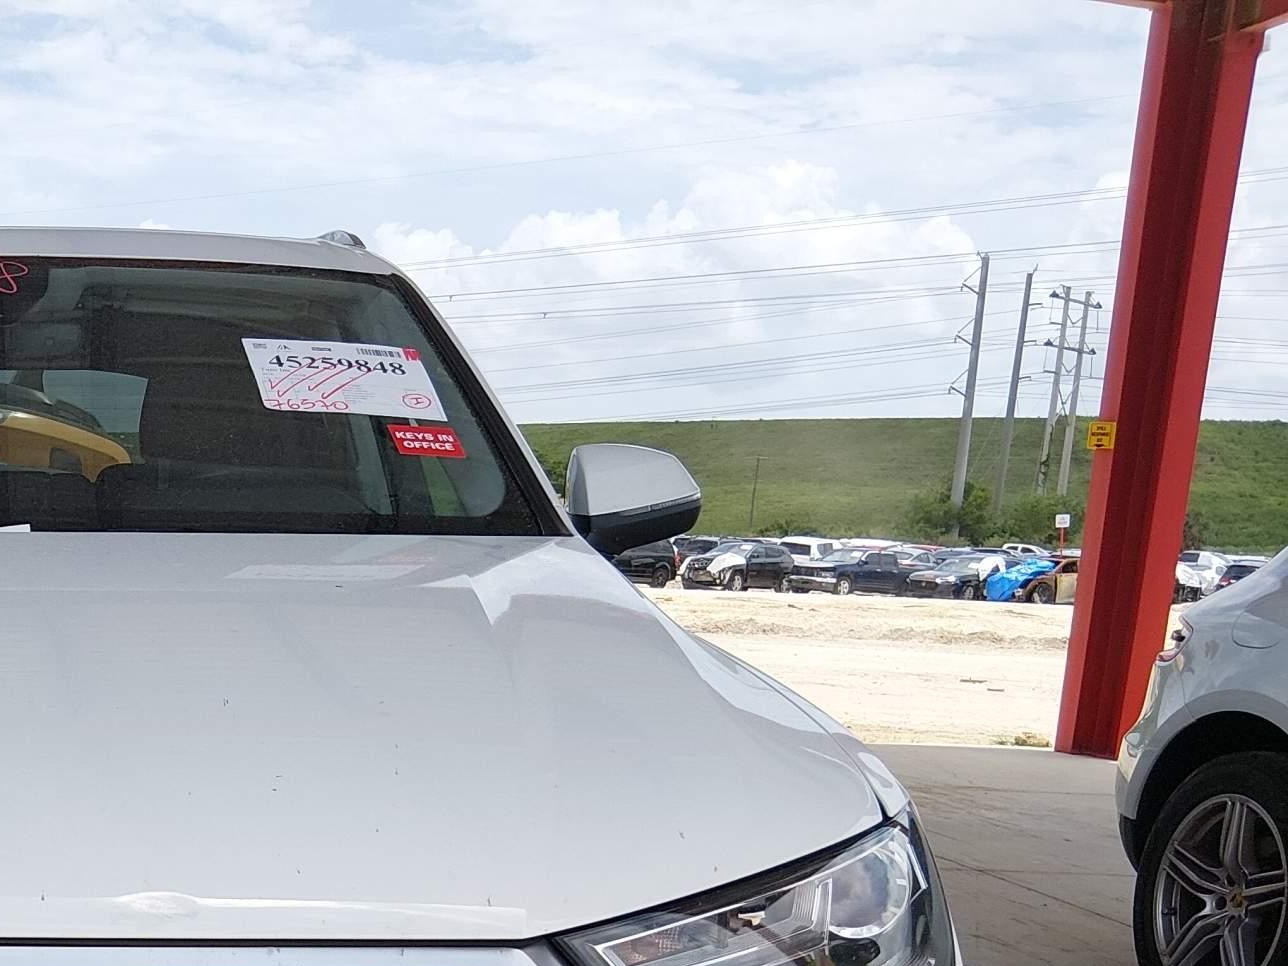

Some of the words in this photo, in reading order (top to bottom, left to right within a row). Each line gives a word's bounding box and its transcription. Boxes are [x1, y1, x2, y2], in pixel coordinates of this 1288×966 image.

[269, 354, 407, 376] 45259848
[394, 431, 434, 442] KEYS
[437, 433, 455, 443] IN
[403, 441, 456, 451] OFFICE
